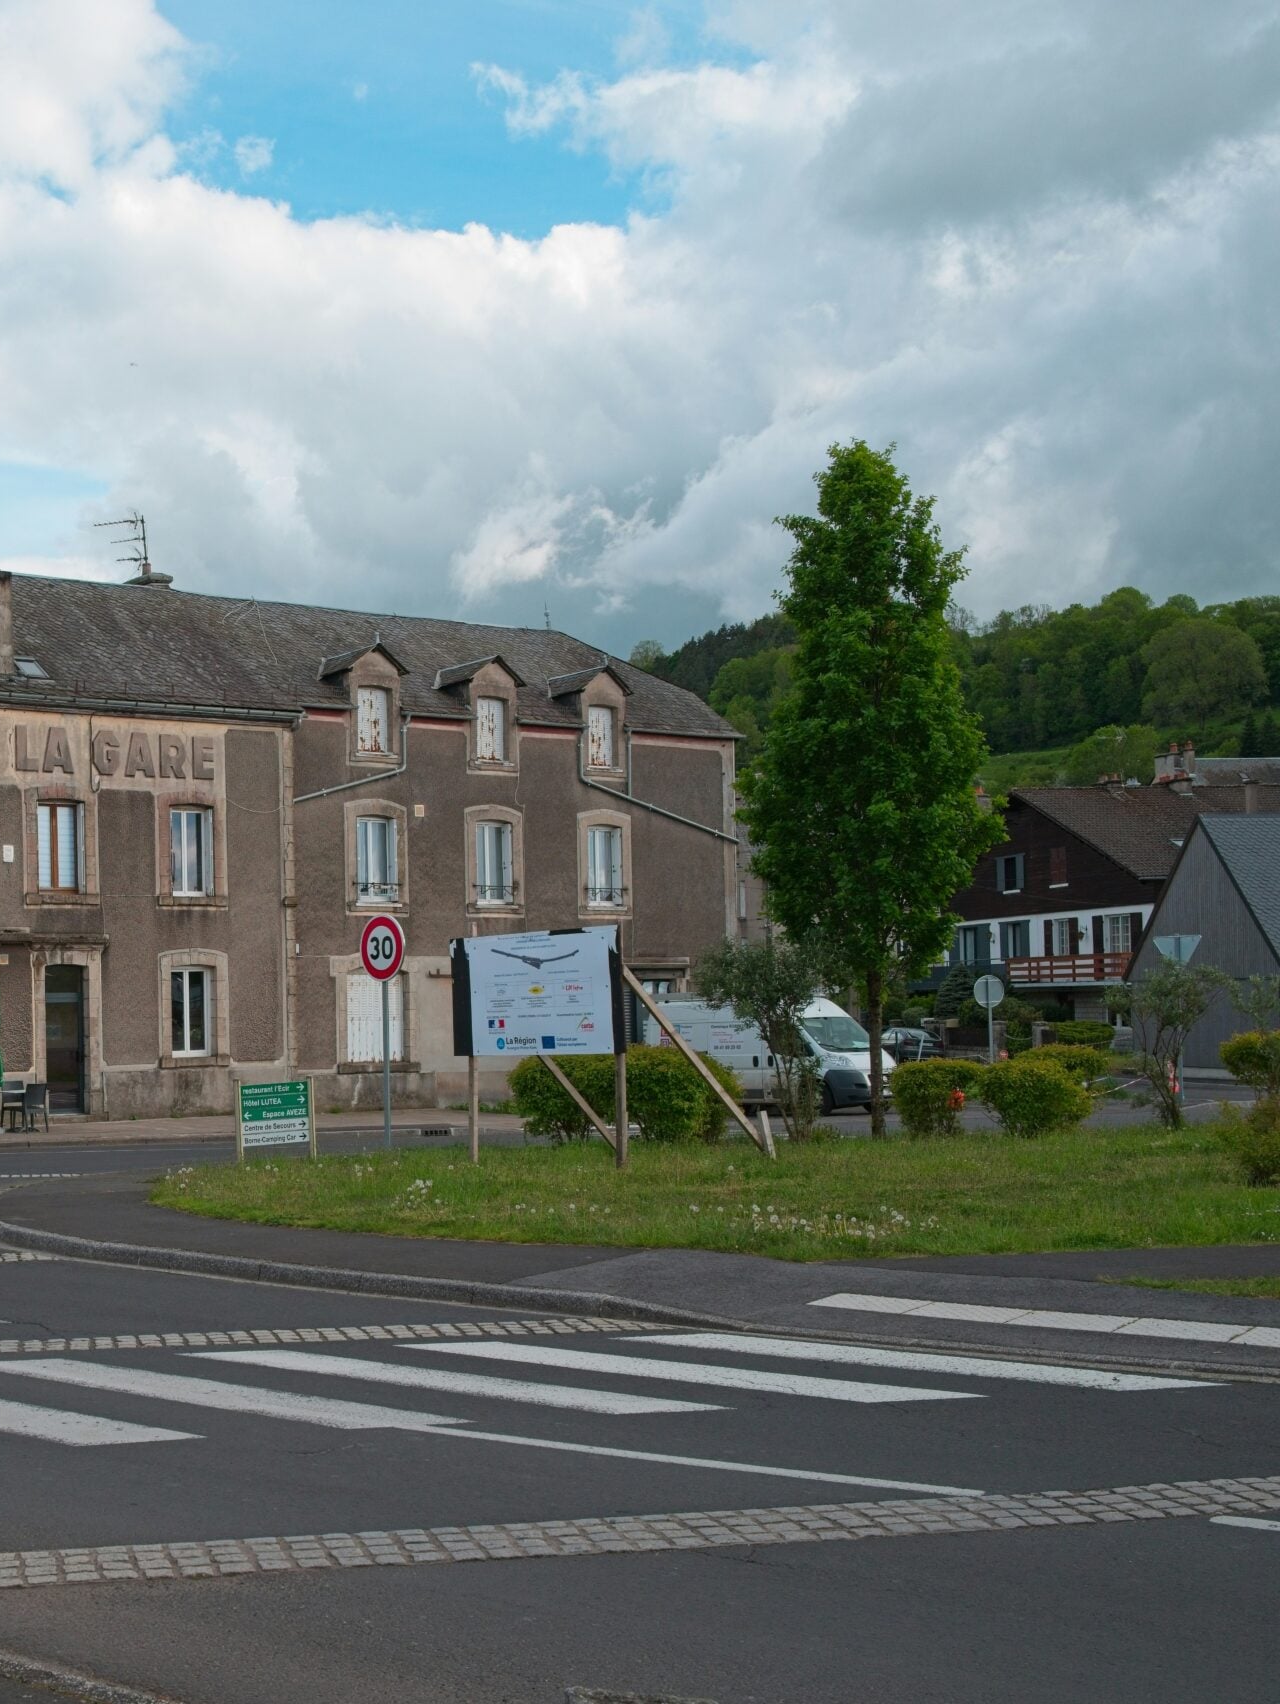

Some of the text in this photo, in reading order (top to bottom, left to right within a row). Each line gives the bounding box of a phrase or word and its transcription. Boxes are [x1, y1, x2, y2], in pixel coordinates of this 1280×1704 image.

[15, 725, 74, 774] LA
[91, 729, 215, 780] GARE
[370, 936, 393, 960] 30
[505, 1036, 537, 1046] La Région
[242, 1086, 274, 1094] restaurant
[243, 1098, 282, 1107] Hôtel LUTEA
[262, 1108, 307, 1119] Espace AVEZE
[273, 1122, 297, 1130] Secours
